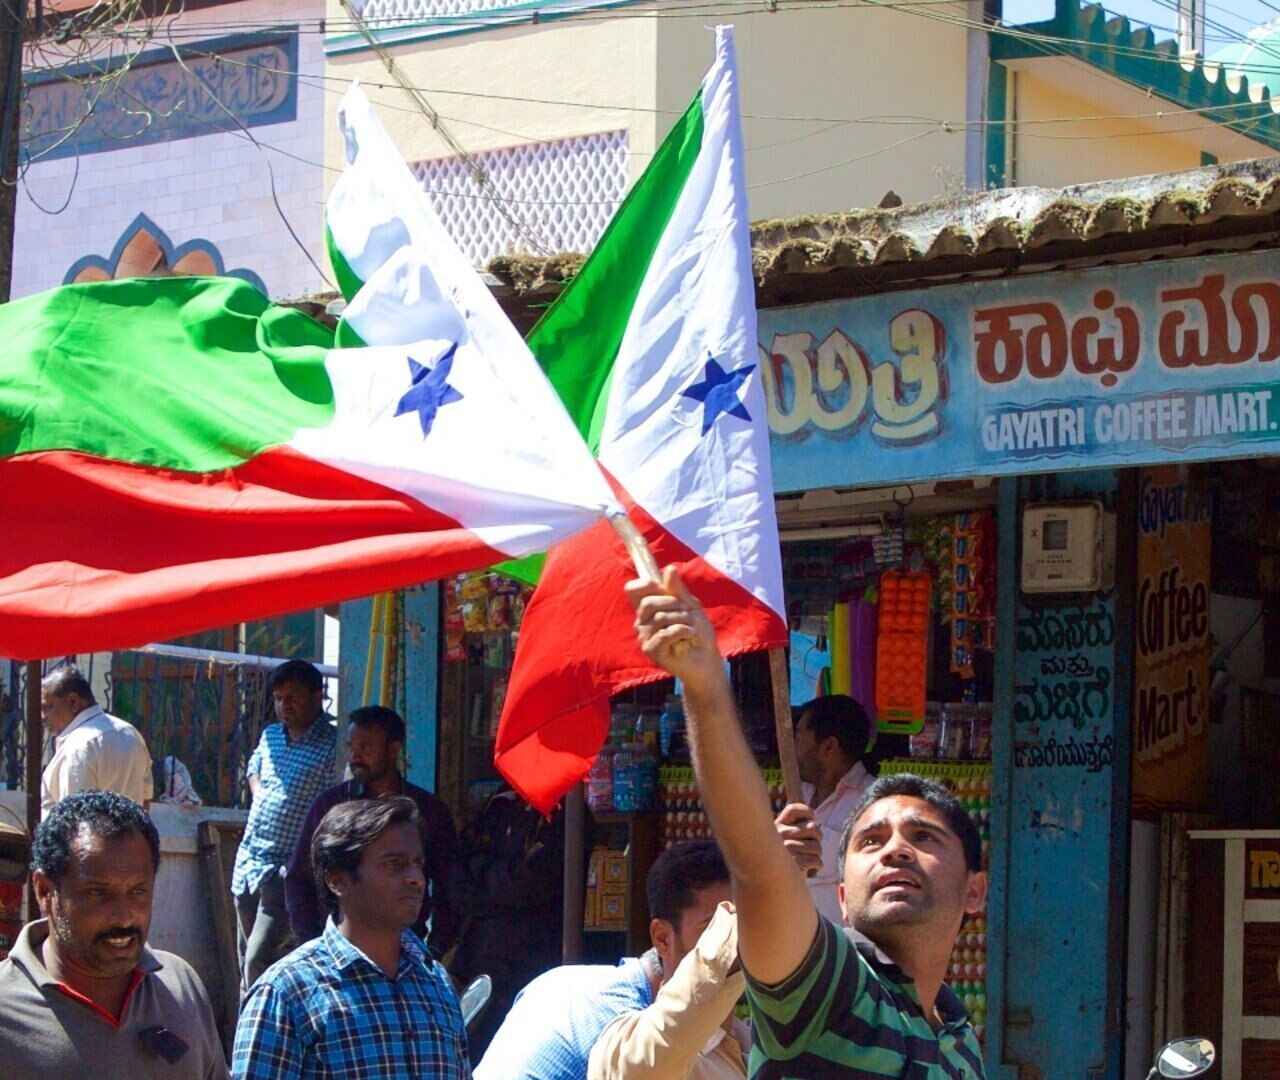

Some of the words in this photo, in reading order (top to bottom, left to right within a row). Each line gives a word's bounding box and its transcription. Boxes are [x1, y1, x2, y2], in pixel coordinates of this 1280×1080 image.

[973, 288, 1141, 388] ಕಾಫಿ
[982, 407, 1087, 452] GAYATRI
[1094, 397, 1188, 445] COFFEE
[1193, 390, 1278, 438] MART.
[1137, 566, 1208, 658] Coffee
[1136, 669, 1199, 753] Mart
